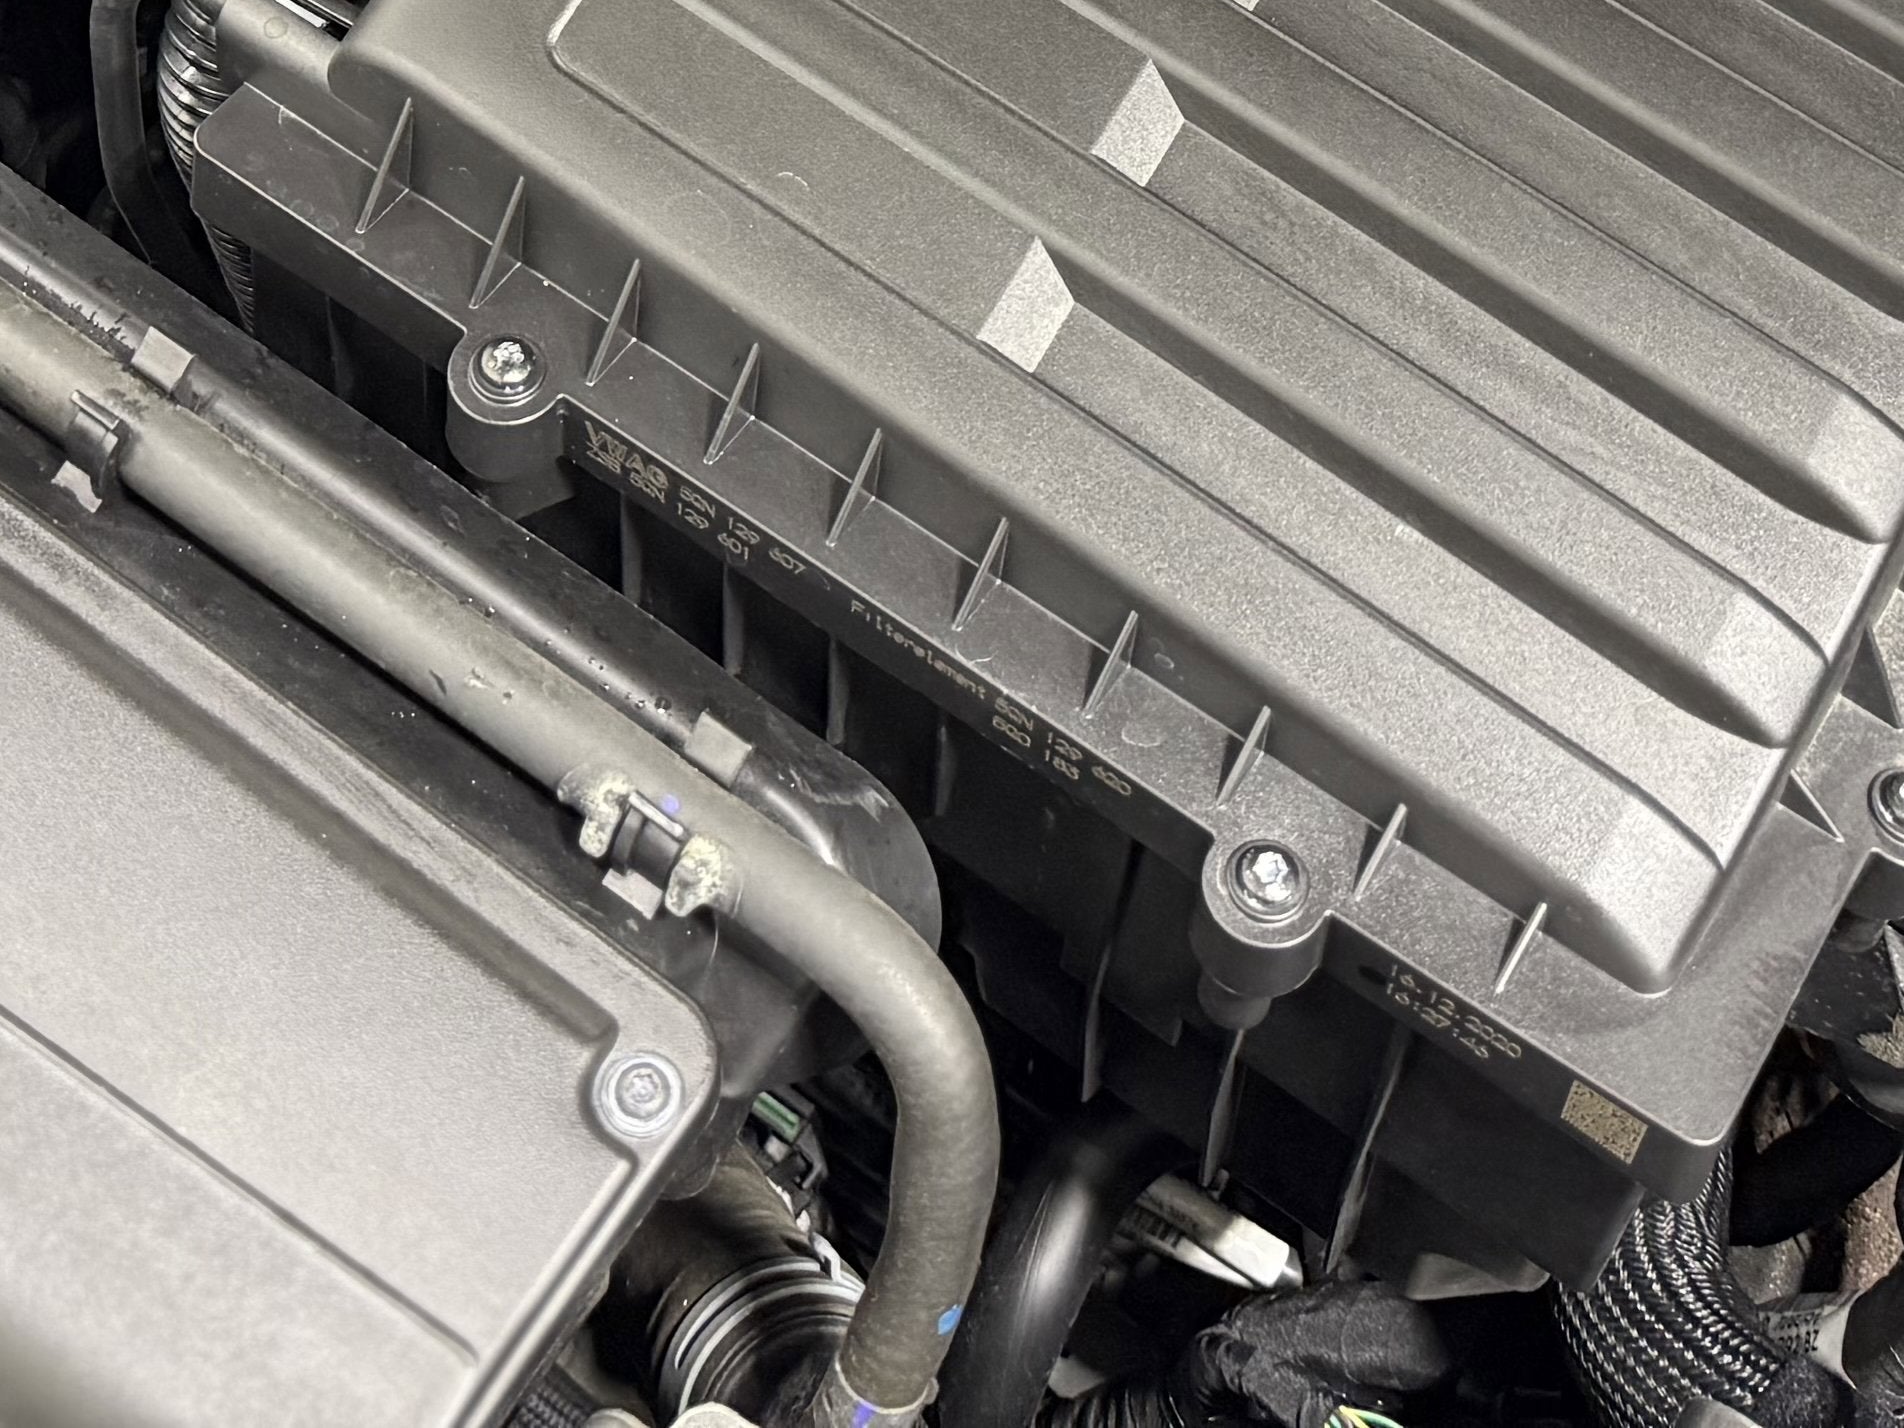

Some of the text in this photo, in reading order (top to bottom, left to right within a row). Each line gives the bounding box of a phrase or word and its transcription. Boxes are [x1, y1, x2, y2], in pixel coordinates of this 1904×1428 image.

[671, 501, 711, 533] 129
[713, 529, 753, 562] 601
[723, 515, 761, 547] 129
[766, 544, 807, 578] 607
[846, 598, 989, 701] Filterelement
[1043, 731, 1084, 764] 129
[1383, 963, 1529, 1059] 16.12.2020
